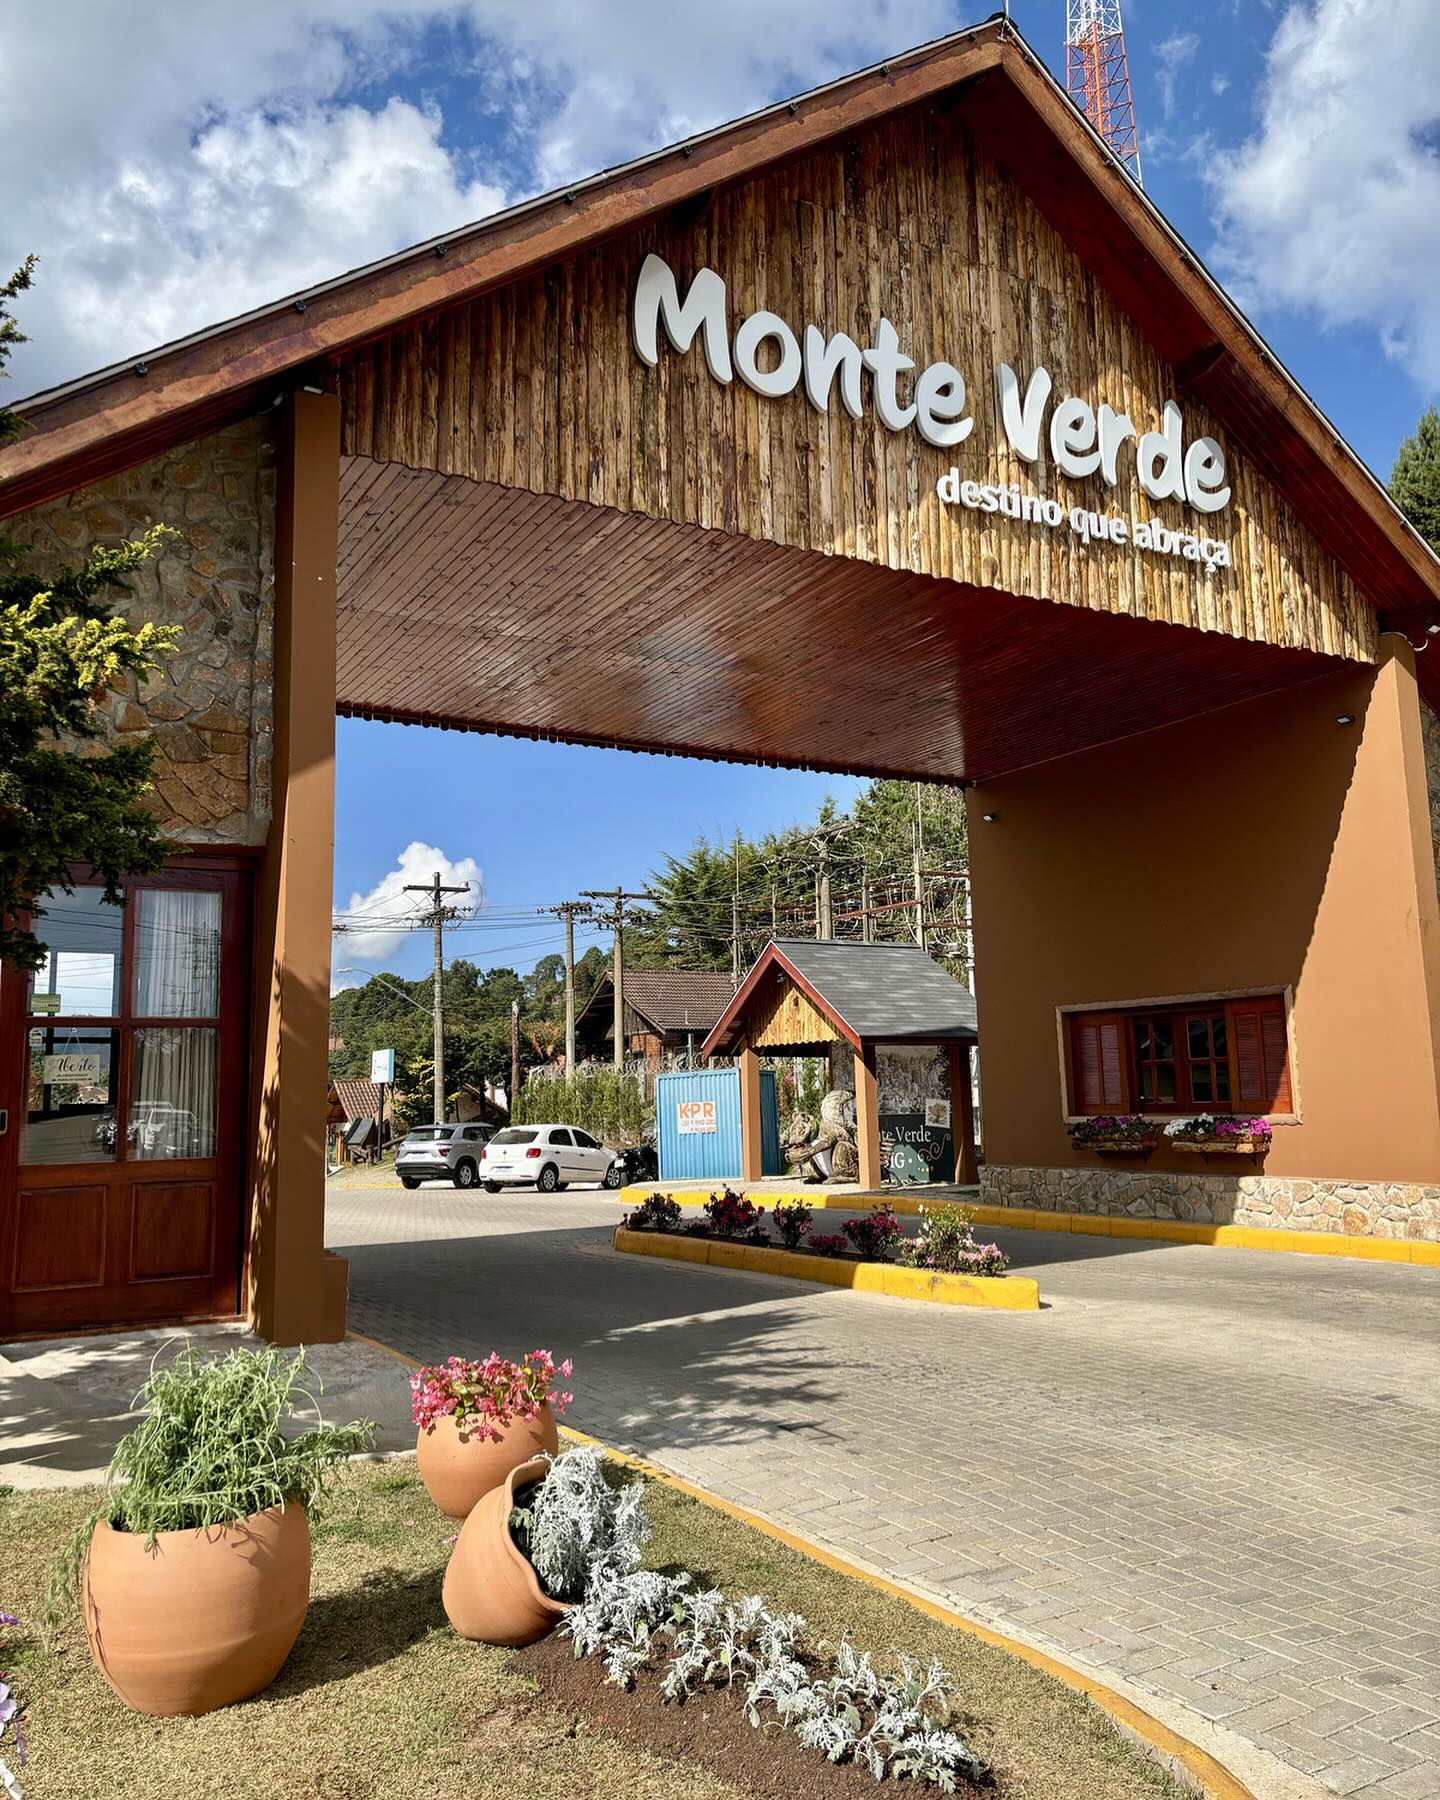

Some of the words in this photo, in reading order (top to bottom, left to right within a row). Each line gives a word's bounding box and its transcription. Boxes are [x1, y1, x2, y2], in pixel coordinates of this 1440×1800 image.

[633, 253, 974, 447] Monte
[998, 362, 1231, 513] Verde
[936, 467, 1062, 527] destino
[1069, 506, 1127, 545] que
[1132, 517, 1231, 573] abraça
[895, 1125, 931, 1143] Verde
